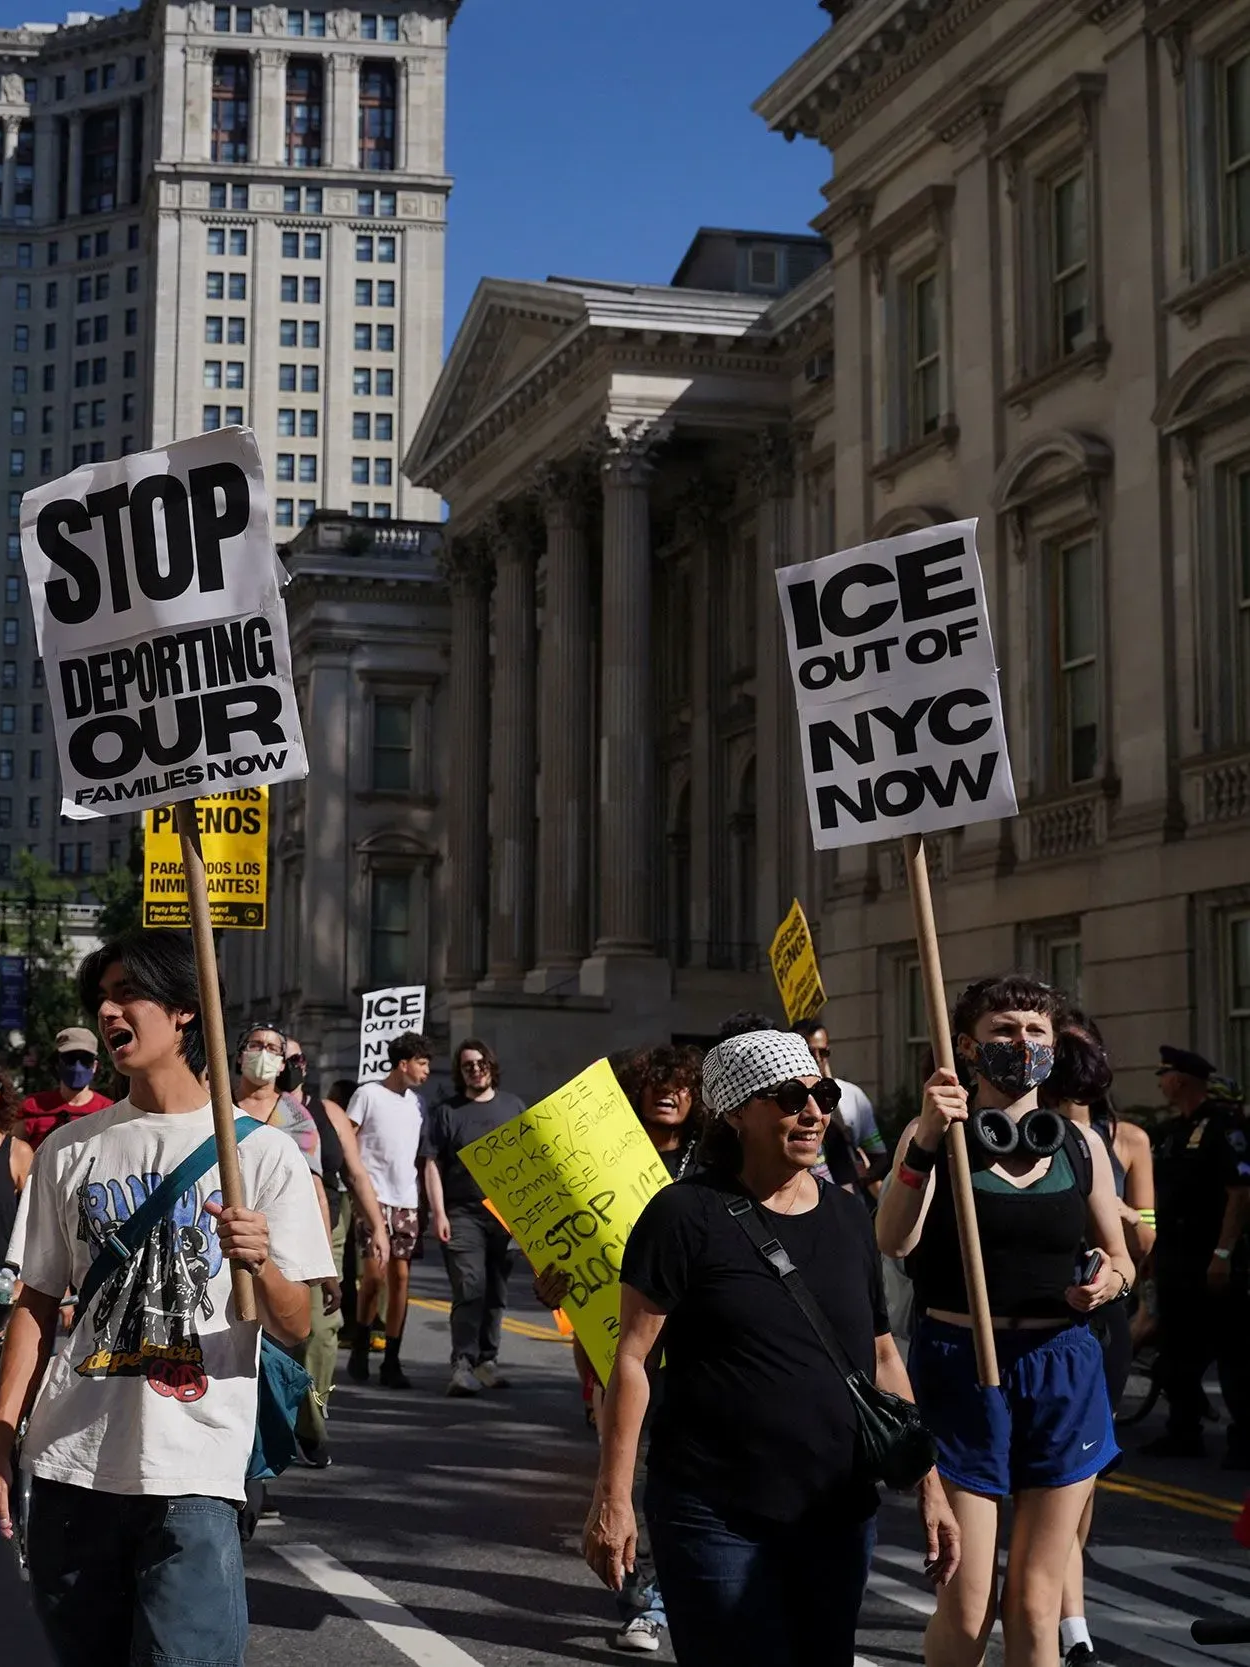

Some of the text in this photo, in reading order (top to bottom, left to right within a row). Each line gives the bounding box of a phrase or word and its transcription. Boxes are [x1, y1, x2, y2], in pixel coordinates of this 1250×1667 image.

[37, 462, 250, 625] STOP
[787, 537, 976, 650] ICE
[60, 616, 276, 720] DEPORTING
[798, 617, 979, 690] OUT OF
[69, 685, 287, 780] OUR
[808, 688, 993, 774] NYC
[75, 750, 288, 806] FAMILIES NOW
[815, 751, 999, 830] NOW
[150, 861, 260, 875] PARA DOS LOS
[150, 878, 259, 894] INMIANTES!
[364, 1017, 421, 1033] OUT OF
[366, 994, 421, 1020] ICE
[362, 1060, 393, 1076] NO
[474, 1080, 593, 1167] ORGANIZE
[513, 1166, 598, 1235] DEFENSE
[545, 1191, 616, 1260] STOP
